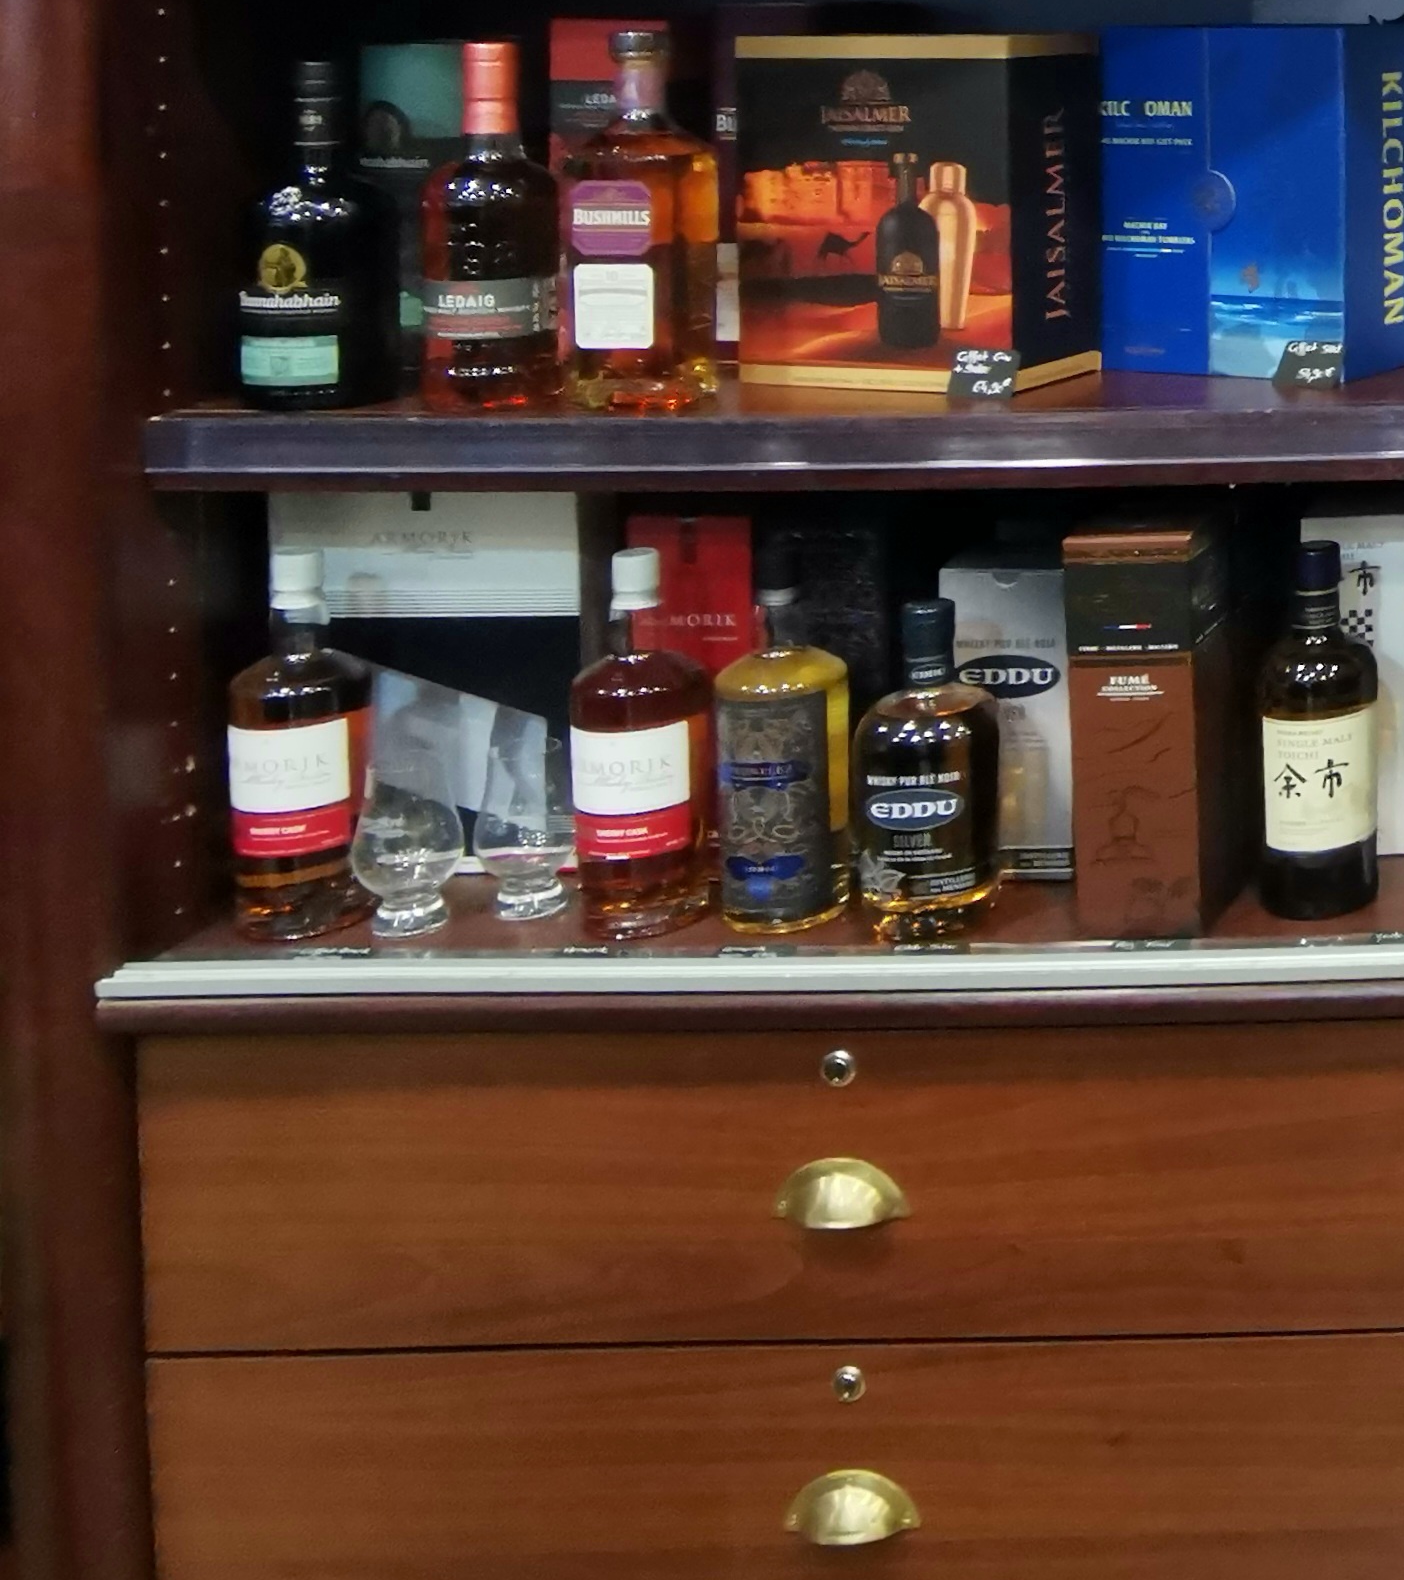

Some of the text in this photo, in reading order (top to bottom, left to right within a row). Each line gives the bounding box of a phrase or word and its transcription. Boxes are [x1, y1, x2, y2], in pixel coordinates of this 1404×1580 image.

[821, 105, 911, 124] JAISALMER
[572, 208, 650, 227] BUSHMILLS
[1044, 106, 1072, 321] JAISALMER
[438, 294, 495, 309] LEDAIG
[959, 666, 1055, 685] EDDU
[1276, 732, 1354, 748] SINGLE MALT
[1274, 758, 1350, 799] 余市
[870, 800, 958, 819] EDDU
